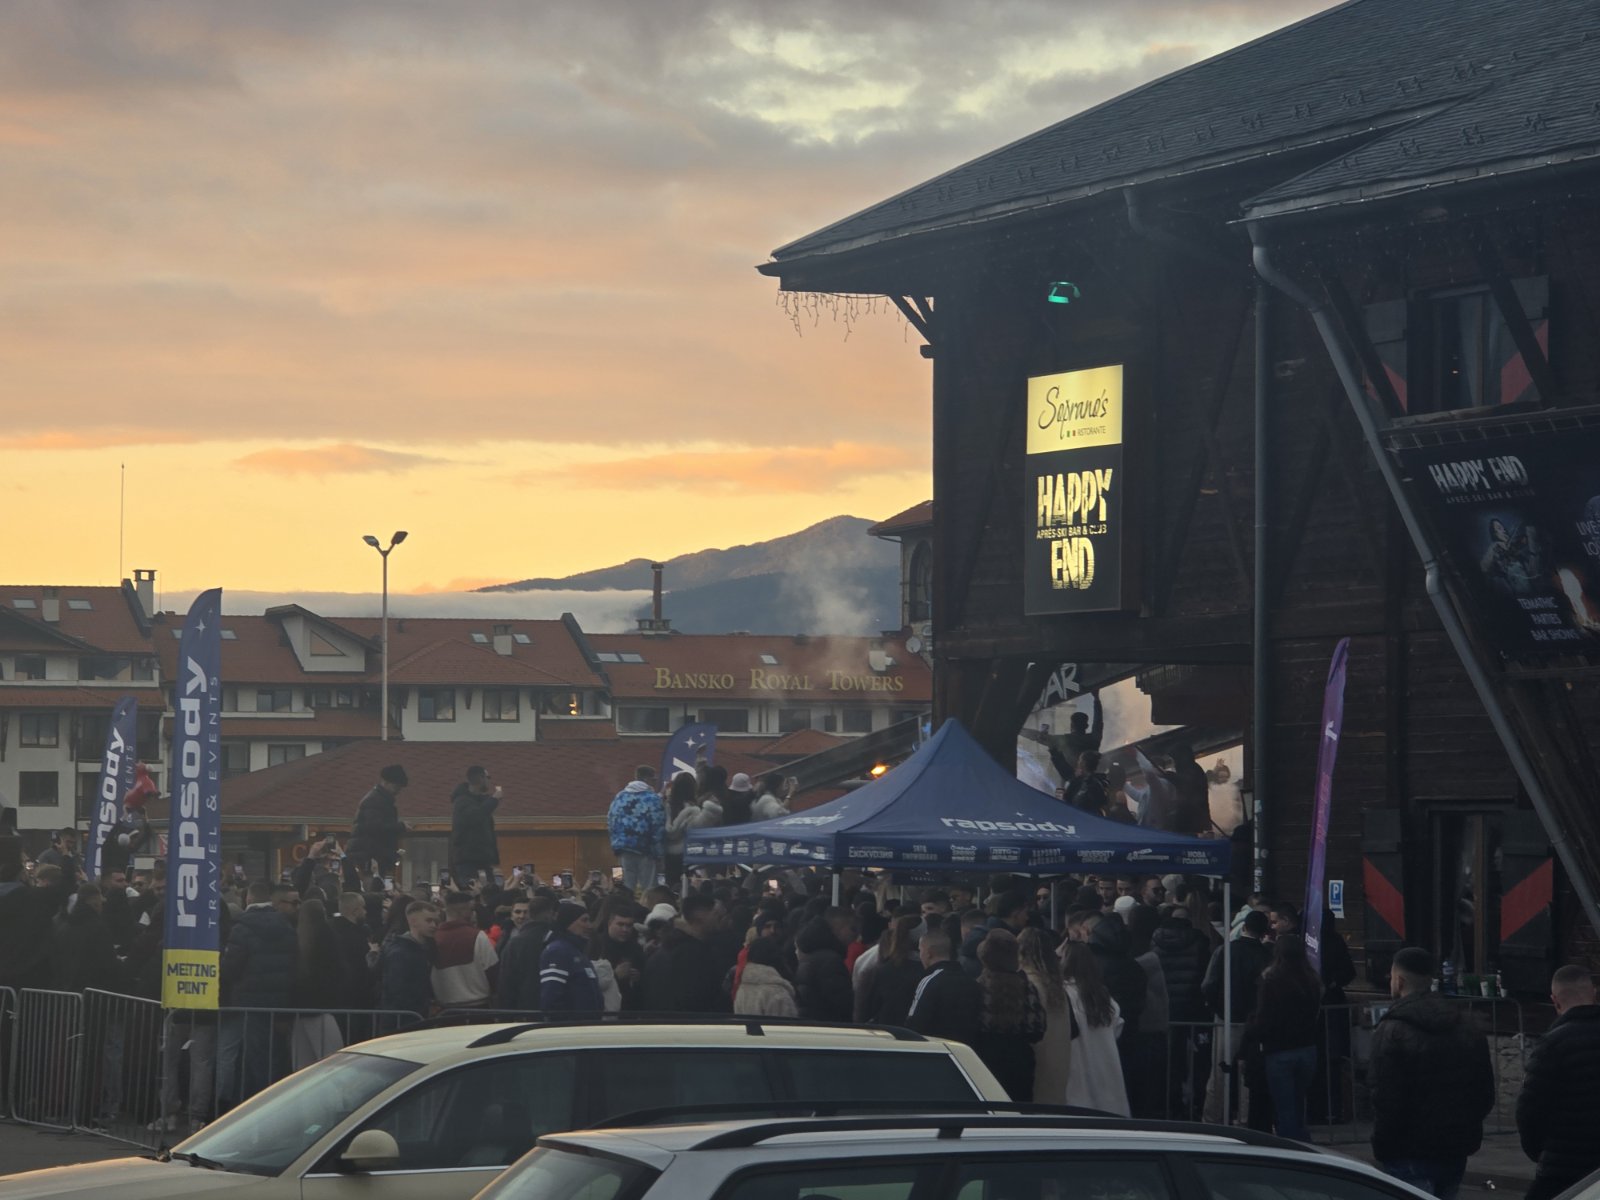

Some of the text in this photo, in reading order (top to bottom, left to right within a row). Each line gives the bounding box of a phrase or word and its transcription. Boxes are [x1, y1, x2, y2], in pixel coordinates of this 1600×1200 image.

[1038, 385, 1109, 440] Soprano's
[1077, 425, 1106, 436] RISTORANTE
[1037, 469, 1113, 527] HAPPY
[1428, 456, 1529, 493] HAPPY END
[1068, 526, 1081, 536] BAR
[1081, 525, 1088, 536] &
[1050, 537, 1095, 590] END
[94, 727, 124, 877] psody
[177, 655, 207, 929] rapsody
[205, 676, 217, 929] TRAVEL & EVENTS
[939, 816, 1077, 835] rapsody
[1332, 883, 1340, 899] P
